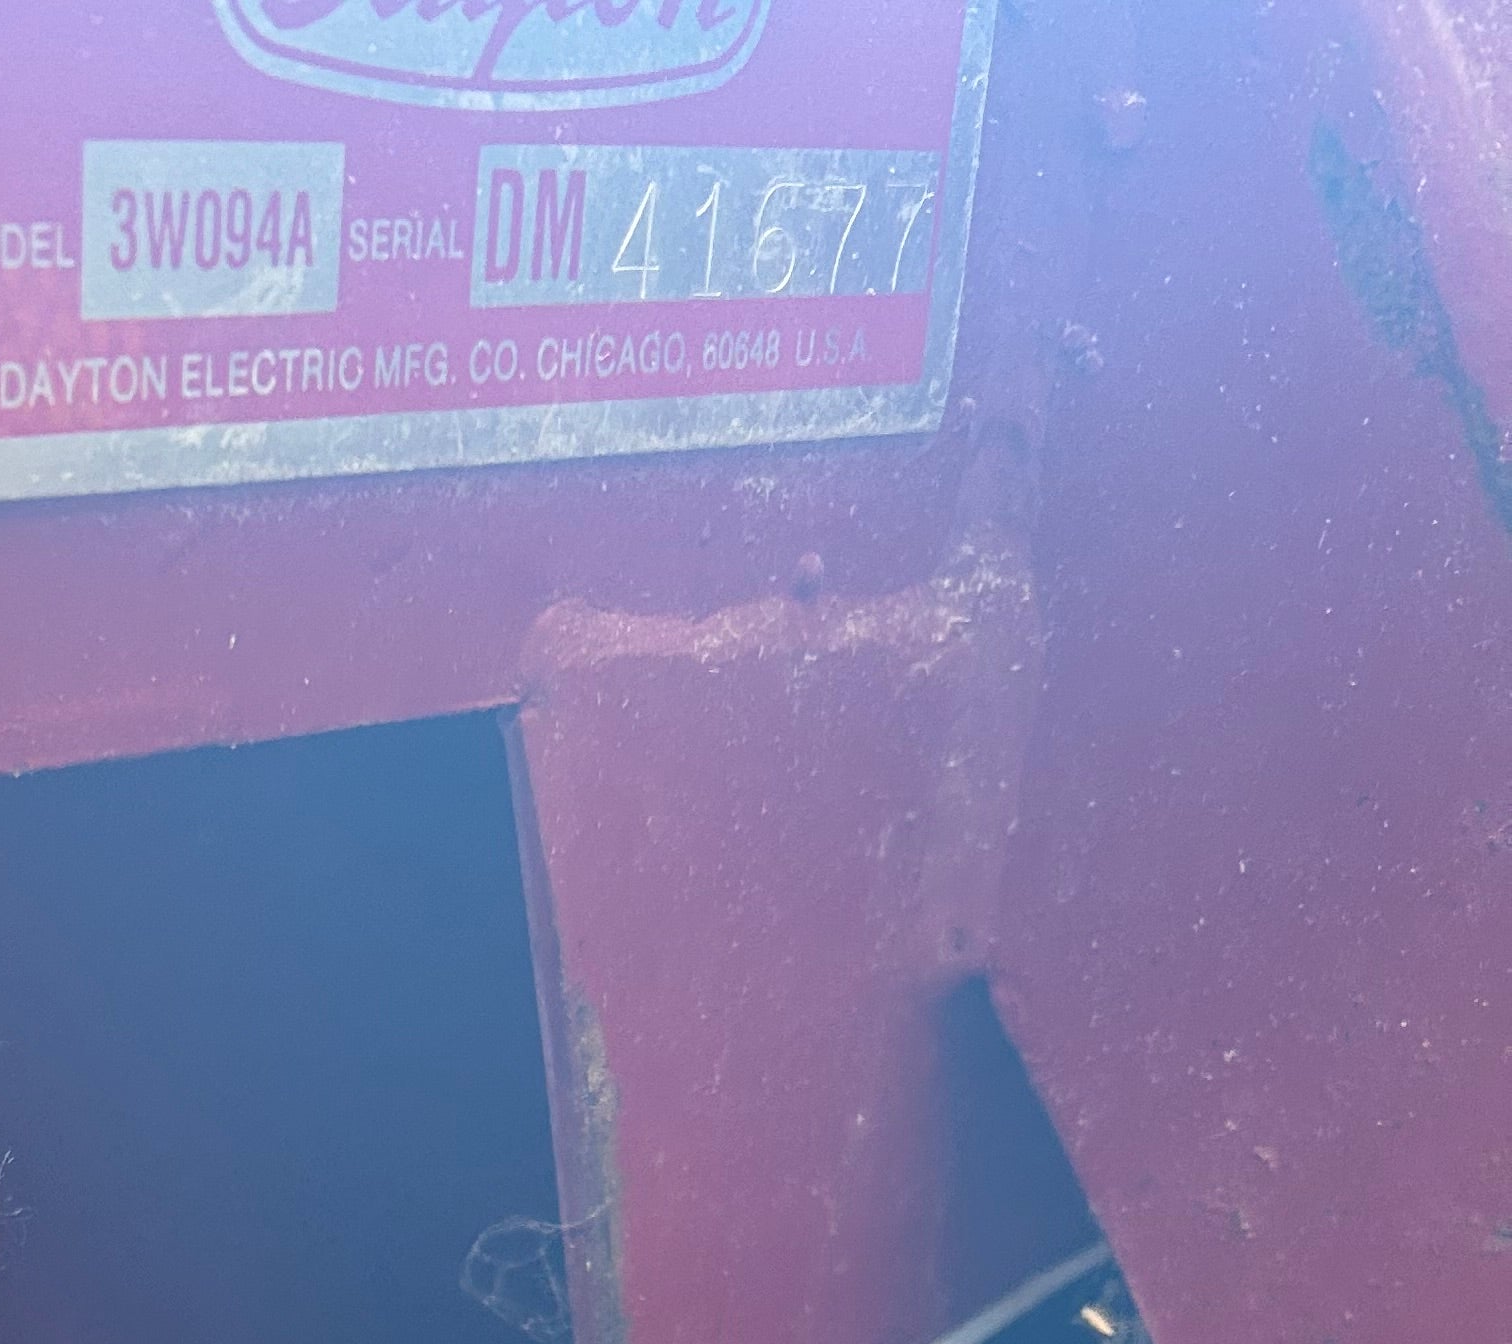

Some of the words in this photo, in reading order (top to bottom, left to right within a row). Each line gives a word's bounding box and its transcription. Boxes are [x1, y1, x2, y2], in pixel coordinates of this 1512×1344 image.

[108, 187, 315, 273] 3W094A
[347, 217, 464, 264] SERIAL
[485, 168, 588, 284] DM
[612, 181, 935, 300] 41677
[0, 355, 168, 411] DAYTON
[180, 346, 362, 401] ELECTRIC
[372, 341, 456, 391] MFG.
[469, 336, 526, 384] CO.
[537, 330, 692, 381] CHICAGO,
[701, 329, 782, 372] 60648
